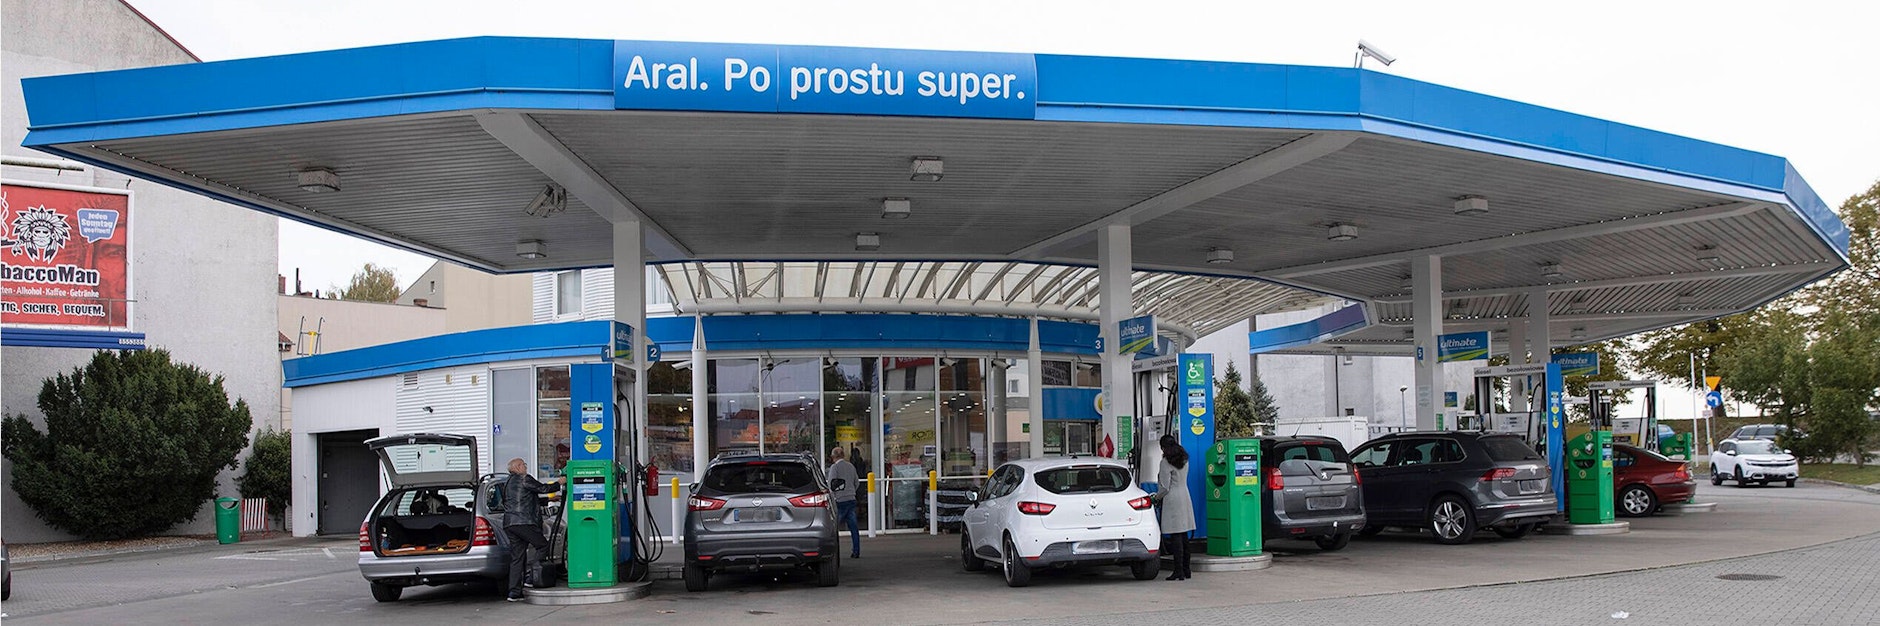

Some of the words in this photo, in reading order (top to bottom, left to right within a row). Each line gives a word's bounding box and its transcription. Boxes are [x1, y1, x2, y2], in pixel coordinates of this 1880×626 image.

[623, 55, 709, 91] Aral.
[724, 57, 771, 93] Po
[790, 62, 905, 101] prostu
[917, 70, 1026, 105] super.
[81, 218, 114, 229] Sonntag
[22, 303, 60, 315] SICHER.
[64, 304, 105, 316] BEQUEM.
[1095, 340, 1102, 350] 3
[1440, 338, 1477, 349] ultimate
[604, 349, 611, 359] 1
[650, 348, 658, 358] 2
